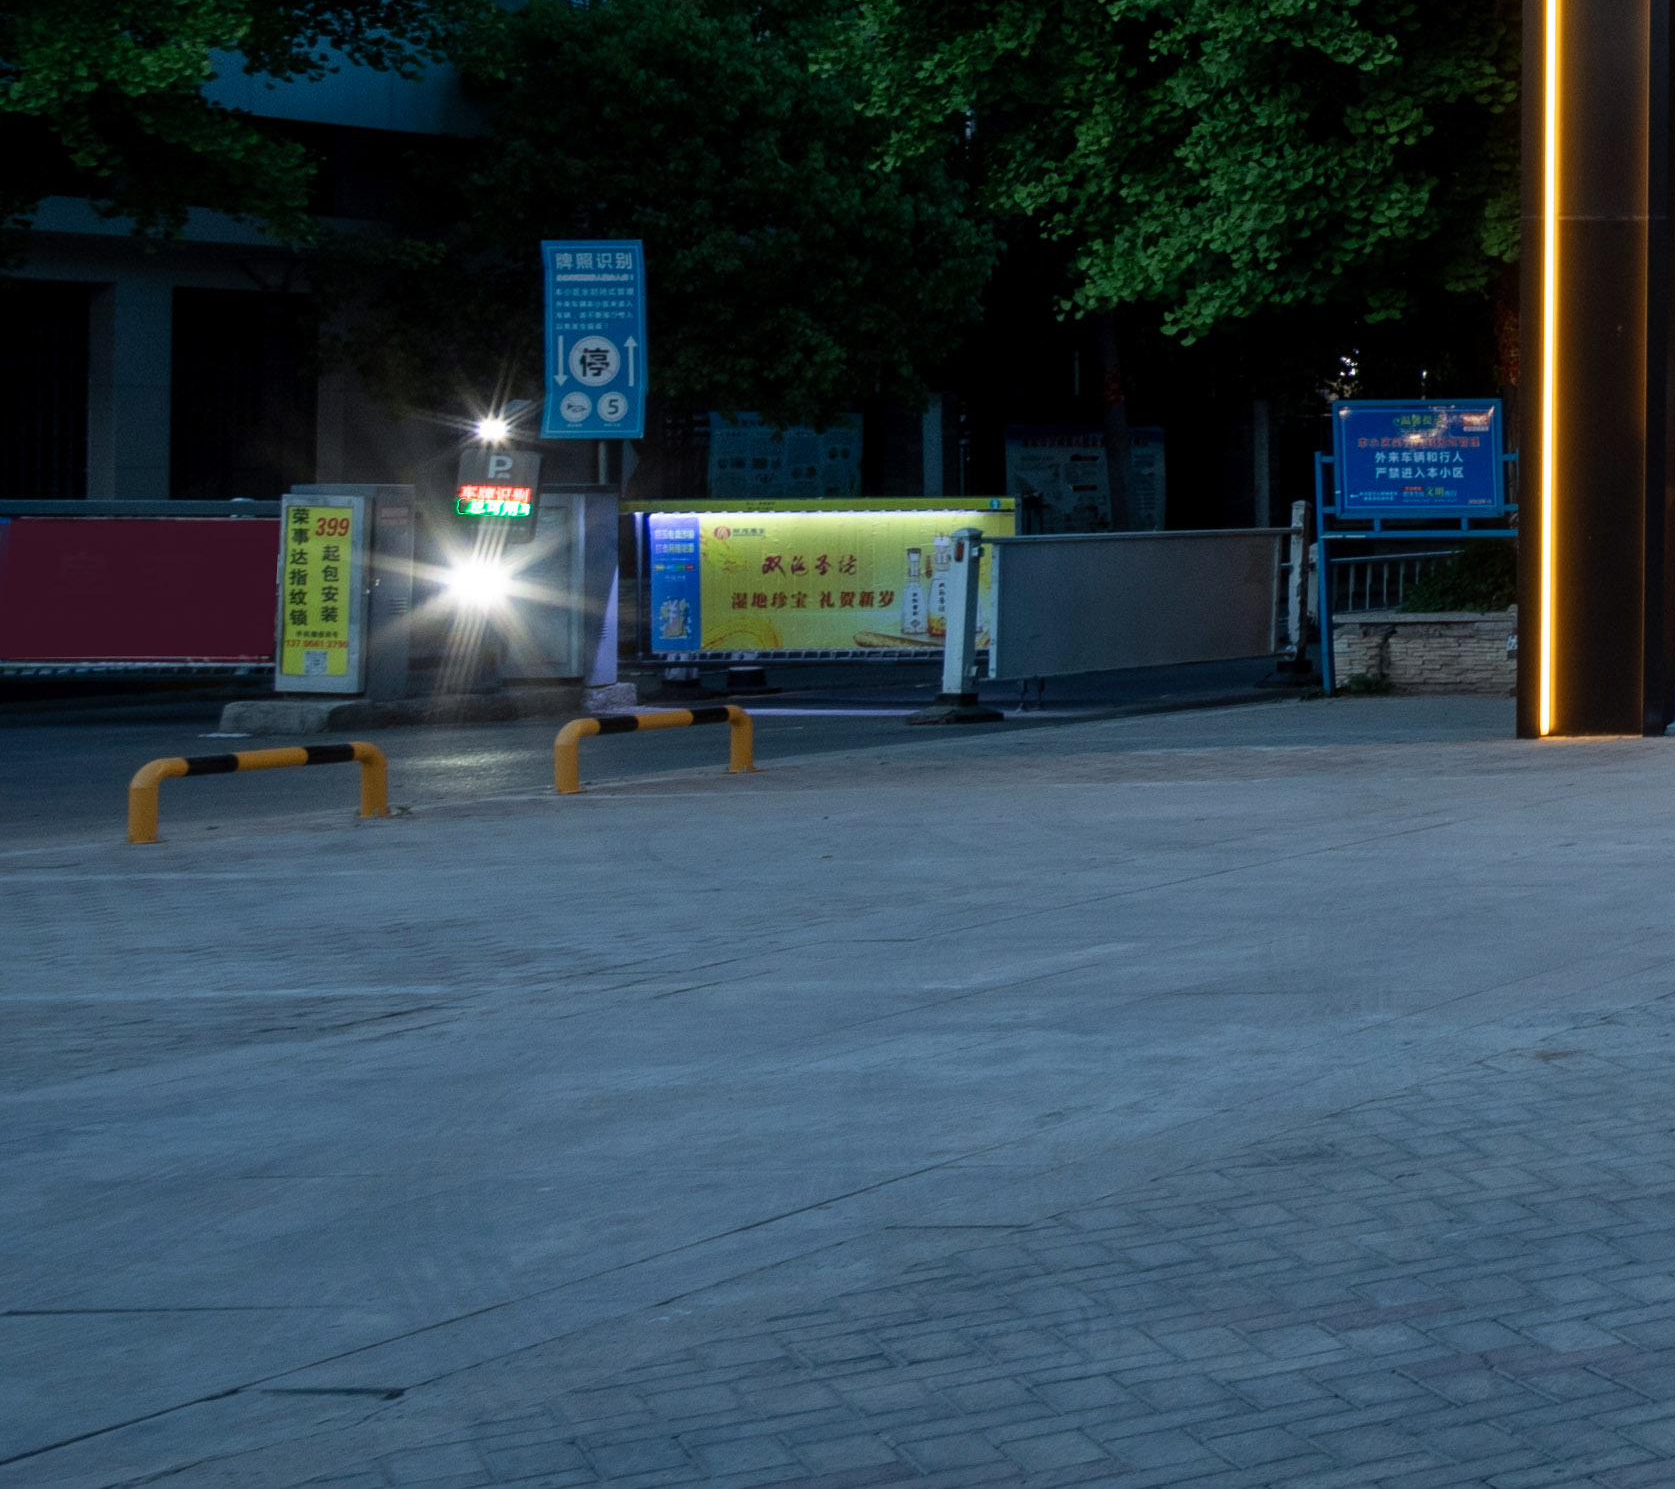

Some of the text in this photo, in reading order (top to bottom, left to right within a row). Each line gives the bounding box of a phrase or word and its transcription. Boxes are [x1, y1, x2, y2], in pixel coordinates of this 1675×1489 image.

[555, 252, 633, 270] 牌照识别
[580, 347, 610, 377] 停
[608, 399, 619, 415] 5
[1375, 451, 1464, 463] 外来车辆和行人
[1375, 467, 1464, 479] 严禁进入本小区
[460, 485, 531, 503] 车牌识别
[315, 517, 350, 537] 399
[289, 508, 310, 626] 荣事达指纹锁
[321, 545, 340, 623] 起包安装
[732, 592, 808, 609] 湿地珍宝
[819, 590, 894, 608] 礼贺新岁
